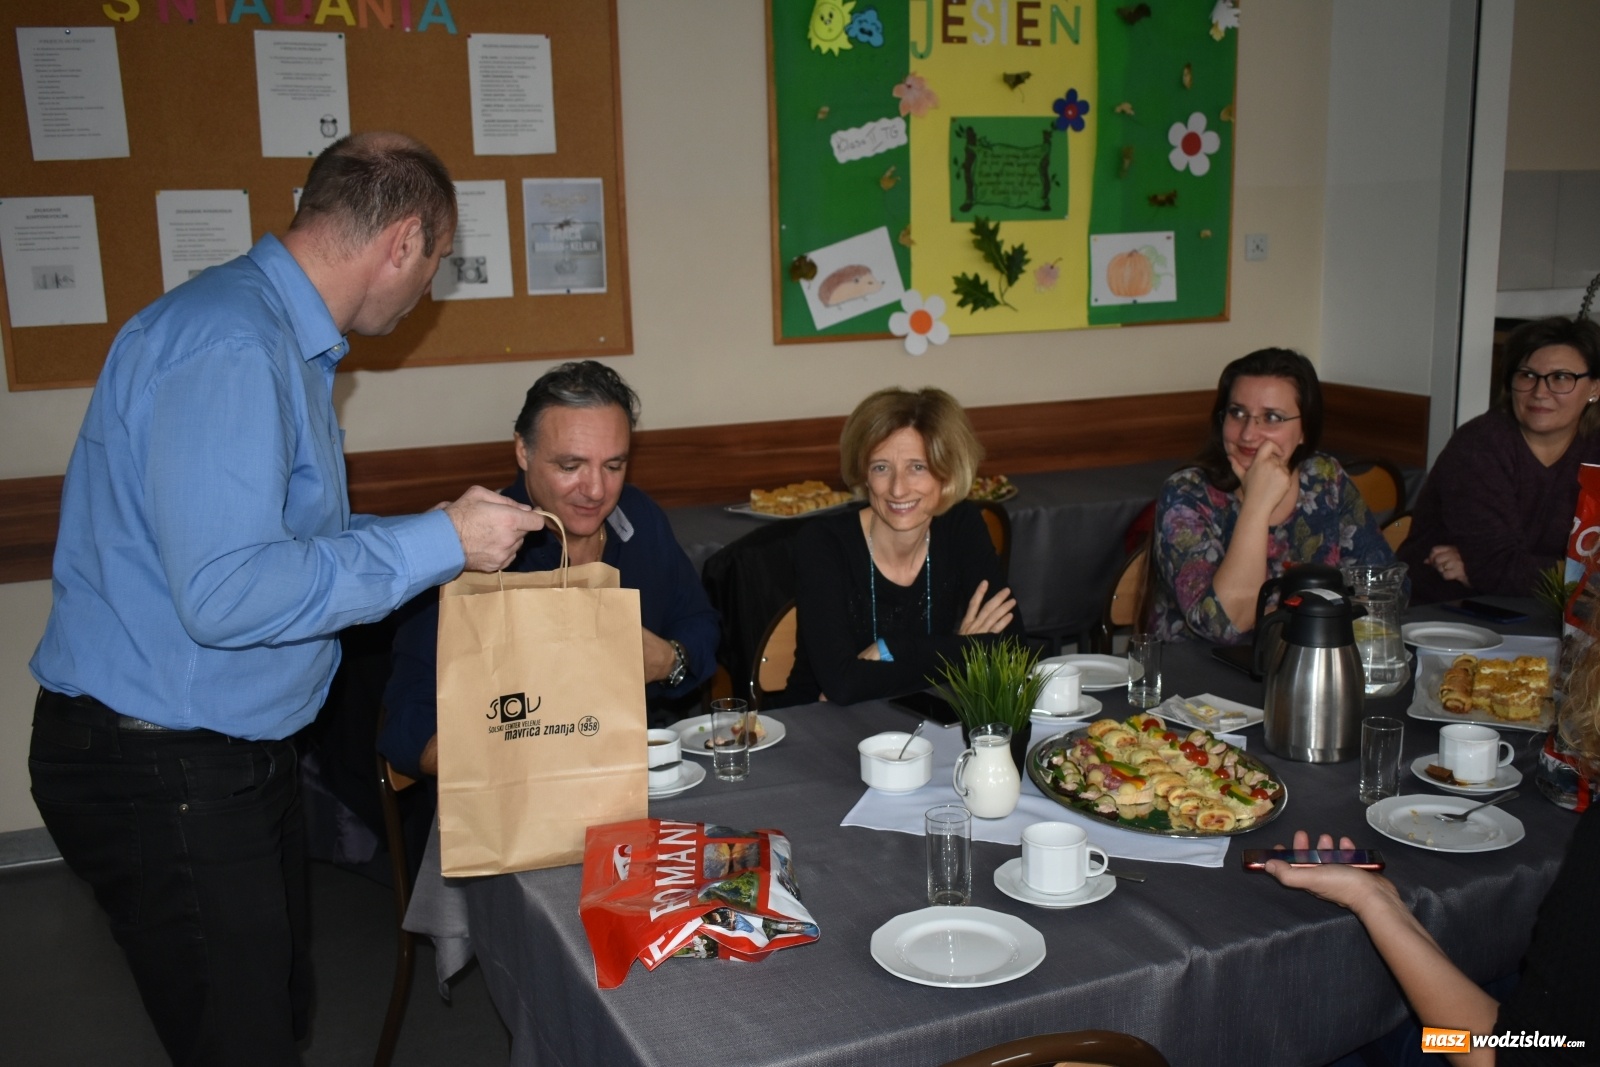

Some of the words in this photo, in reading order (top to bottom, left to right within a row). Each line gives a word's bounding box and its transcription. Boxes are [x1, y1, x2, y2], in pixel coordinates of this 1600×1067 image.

[505, 721, 522, 731] CENTER
[522, 719, 541, 728] VELENJE
[580, 721, 598, 732] 1958
[504, 726, 541, 741] mavrica
[543, 723, 575, 736] znanja
